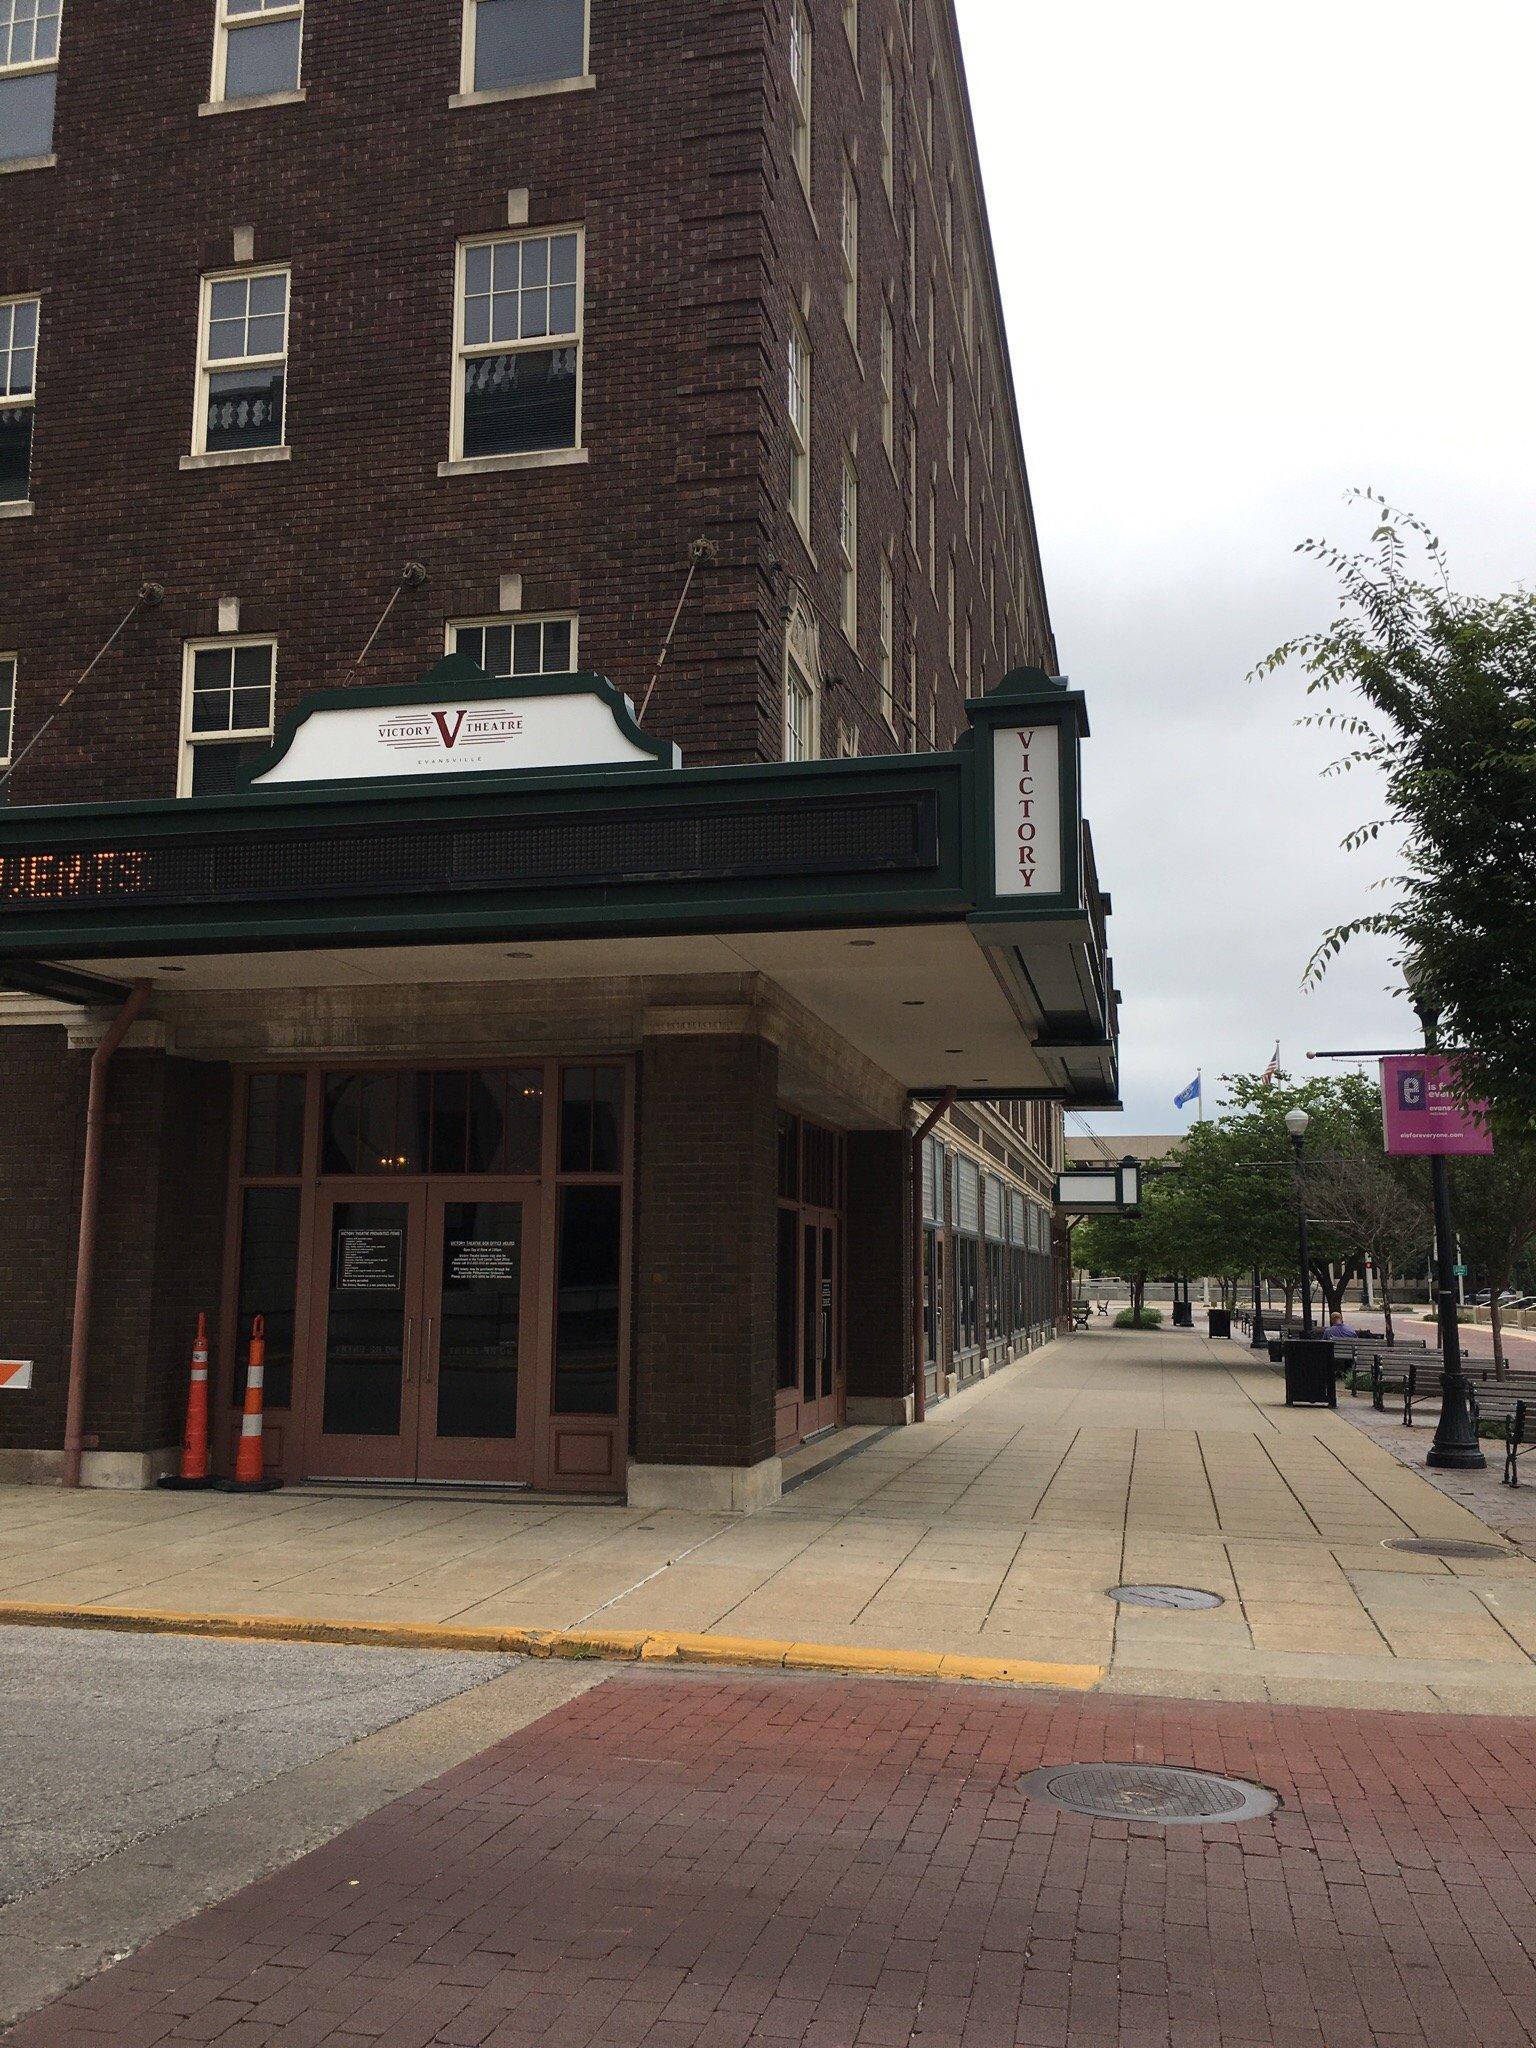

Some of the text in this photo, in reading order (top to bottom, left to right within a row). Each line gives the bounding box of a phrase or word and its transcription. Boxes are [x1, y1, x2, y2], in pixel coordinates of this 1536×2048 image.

[378, 710, 523, 748] VICTORY V THEATRE
[418, 757, 482, 765] EVANSVILLE
[1017, 731, 1036, 887] VICTORY
[1427, 1082, 1437, 1091] is
